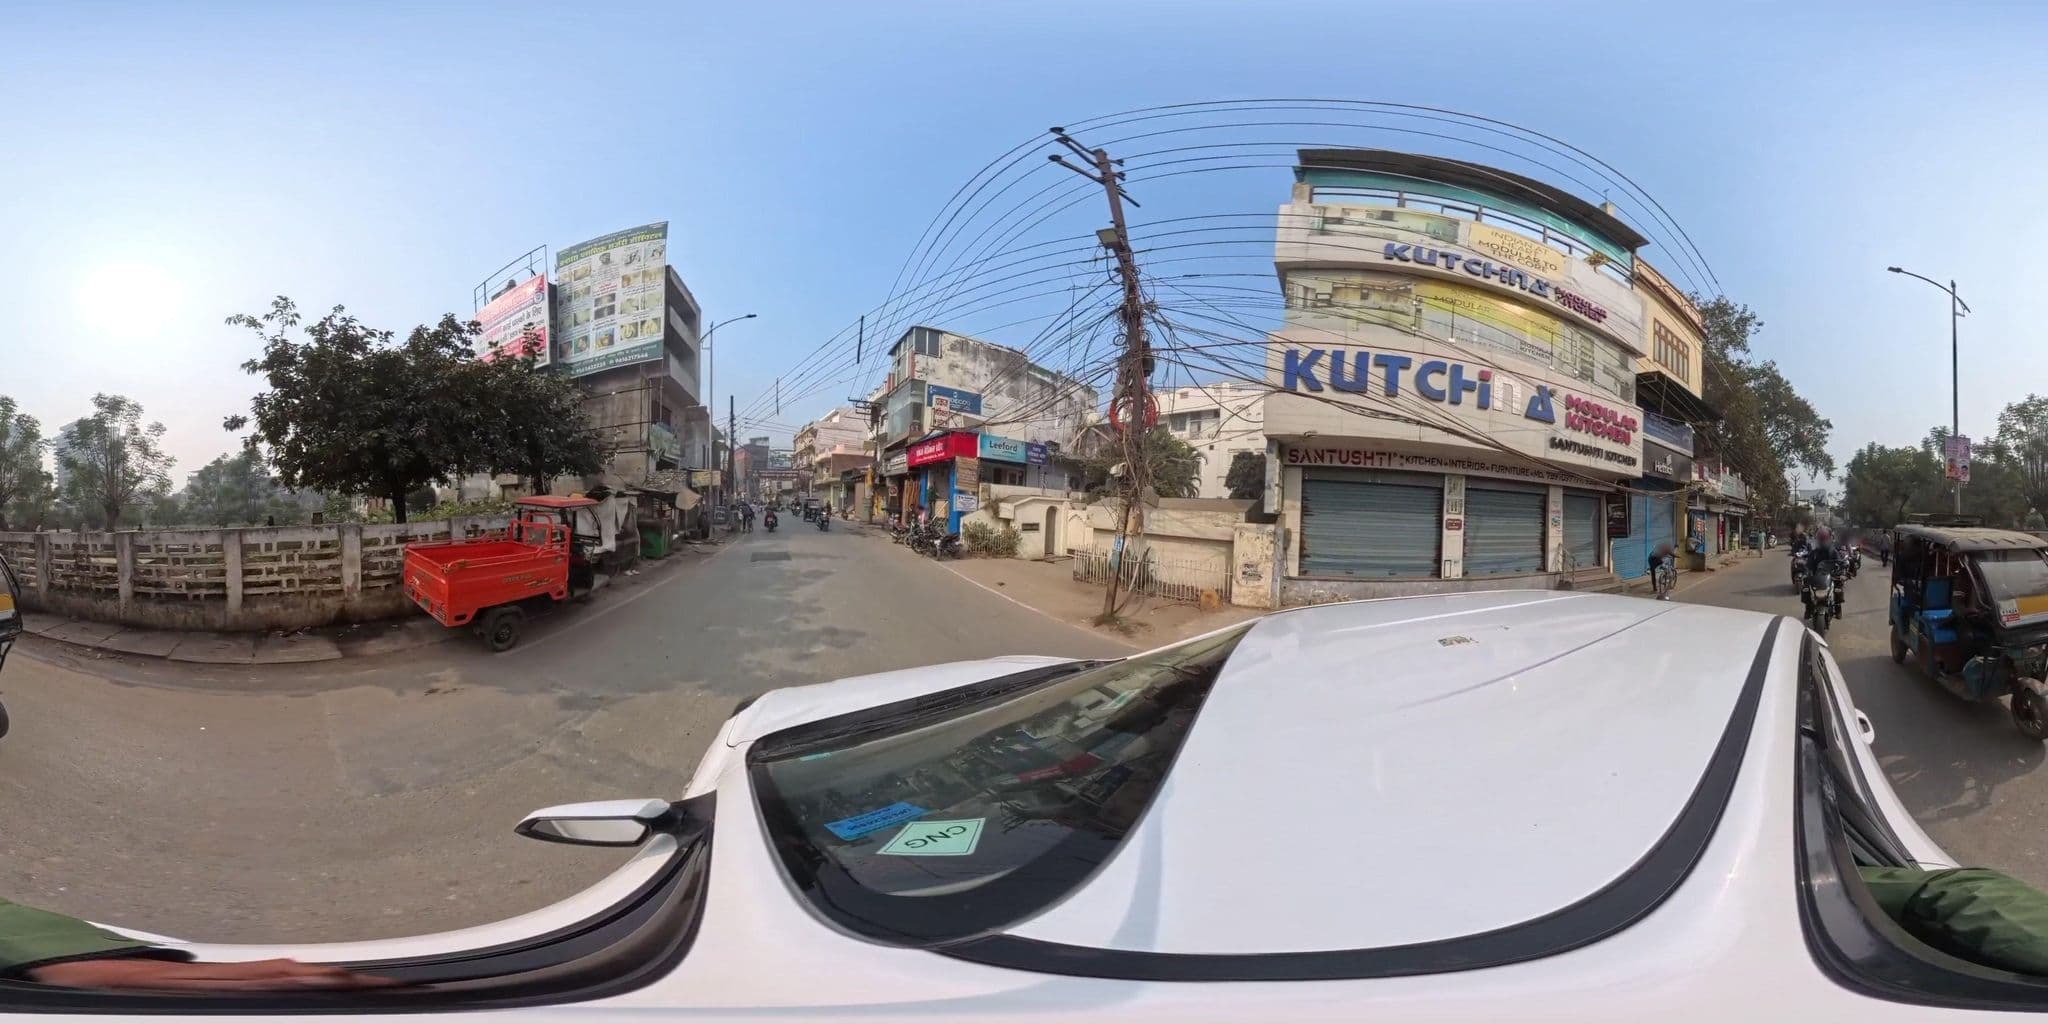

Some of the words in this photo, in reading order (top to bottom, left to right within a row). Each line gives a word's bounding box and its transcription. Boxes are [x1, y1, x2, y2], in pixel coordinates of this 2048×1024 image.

[1491, 231, 1533, 249] INDIAN
[1478, 240, 1540, 263] MODULAR
[1542, 260, 1557, 271] TO
[1492, 250, 1515, 261] THE
[1517, 257, 1548, 273] CORE
[1555, 286, 1607, 319] MODULAR
[1566, 394, 1637, 432] MODULAR
[1566, 415, 1631, 446] KITCHEN
[989, 440, 1018, 452] Leeford
[1549, 436, 1602, 459] SANTUSHTI
[1604, 449, 1637, 467] KITCHEN
[1405, 455, 1443, 467] KITCHEN
[1449, 458, 1486, 471] INTERIOR
[1491, 464, 1530, 477] FURNITURE
[904, 825, 967, 849] CNG
